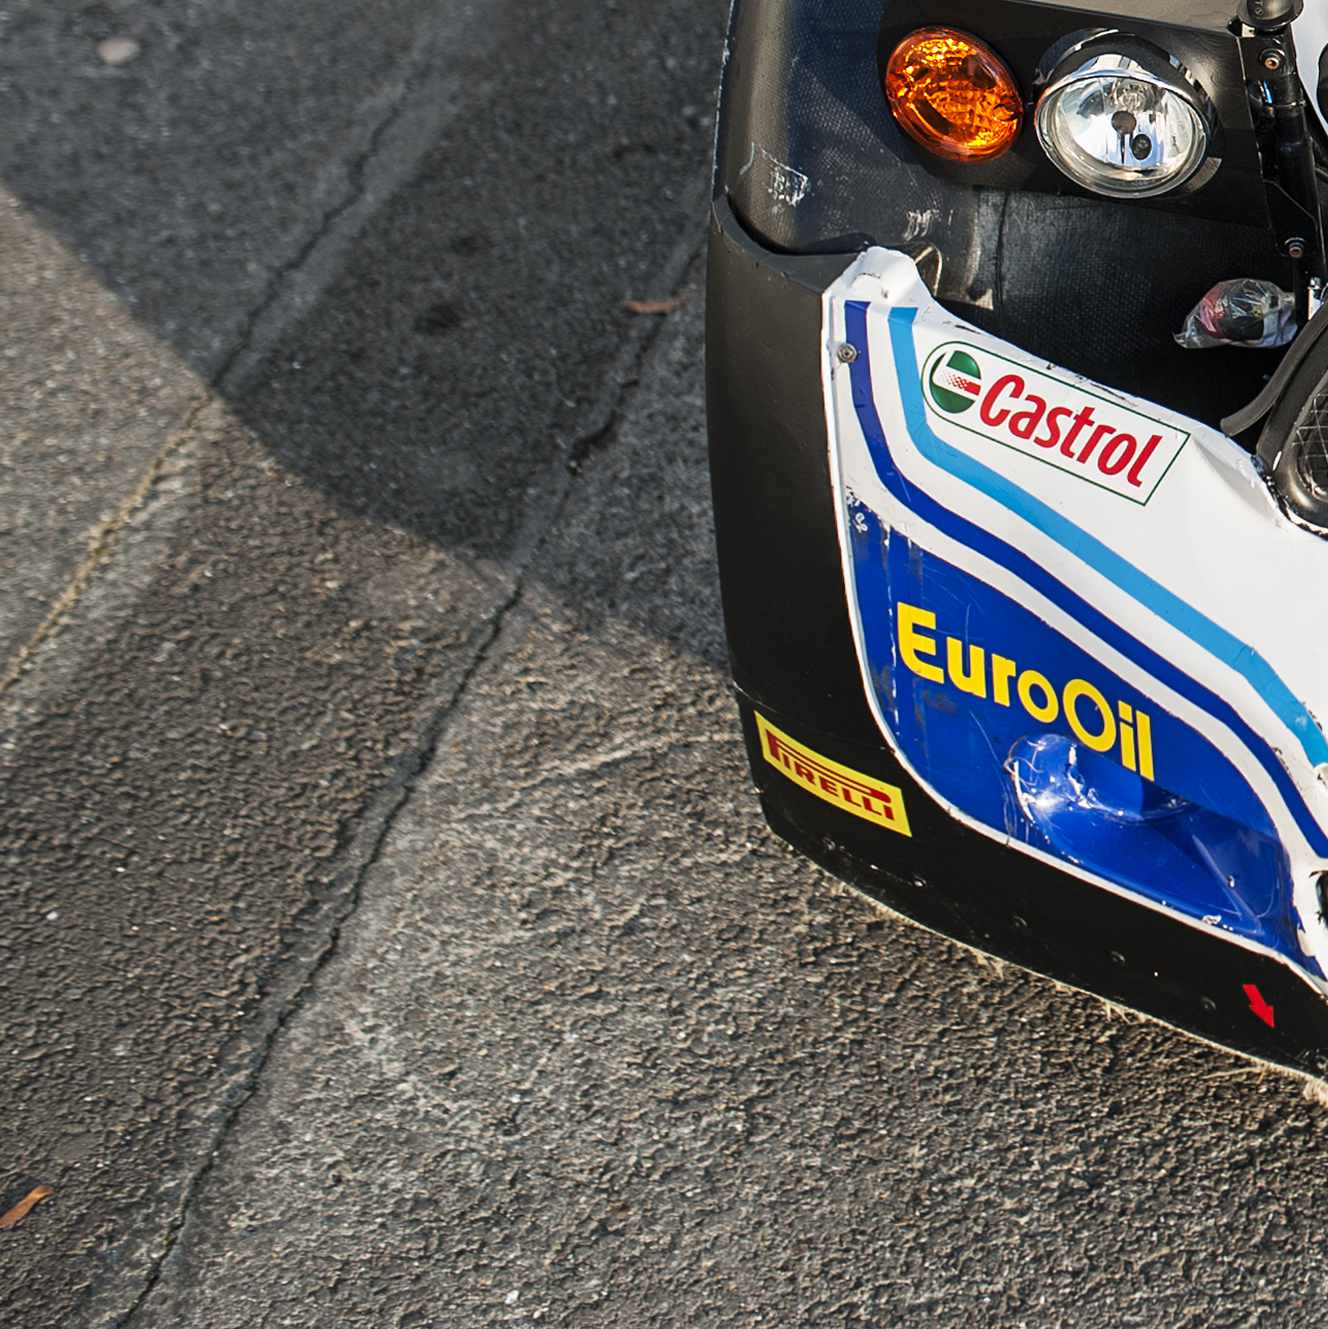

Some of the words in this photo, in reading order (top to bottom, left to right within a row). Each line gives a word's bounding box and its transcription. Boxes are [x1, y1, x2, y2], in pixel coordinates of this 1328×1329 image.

[979, 373, 1163, 488] Castrol
[897, 602, 1154, 781] EuroOil
[765, 729, 896, 821] PIRELLI
